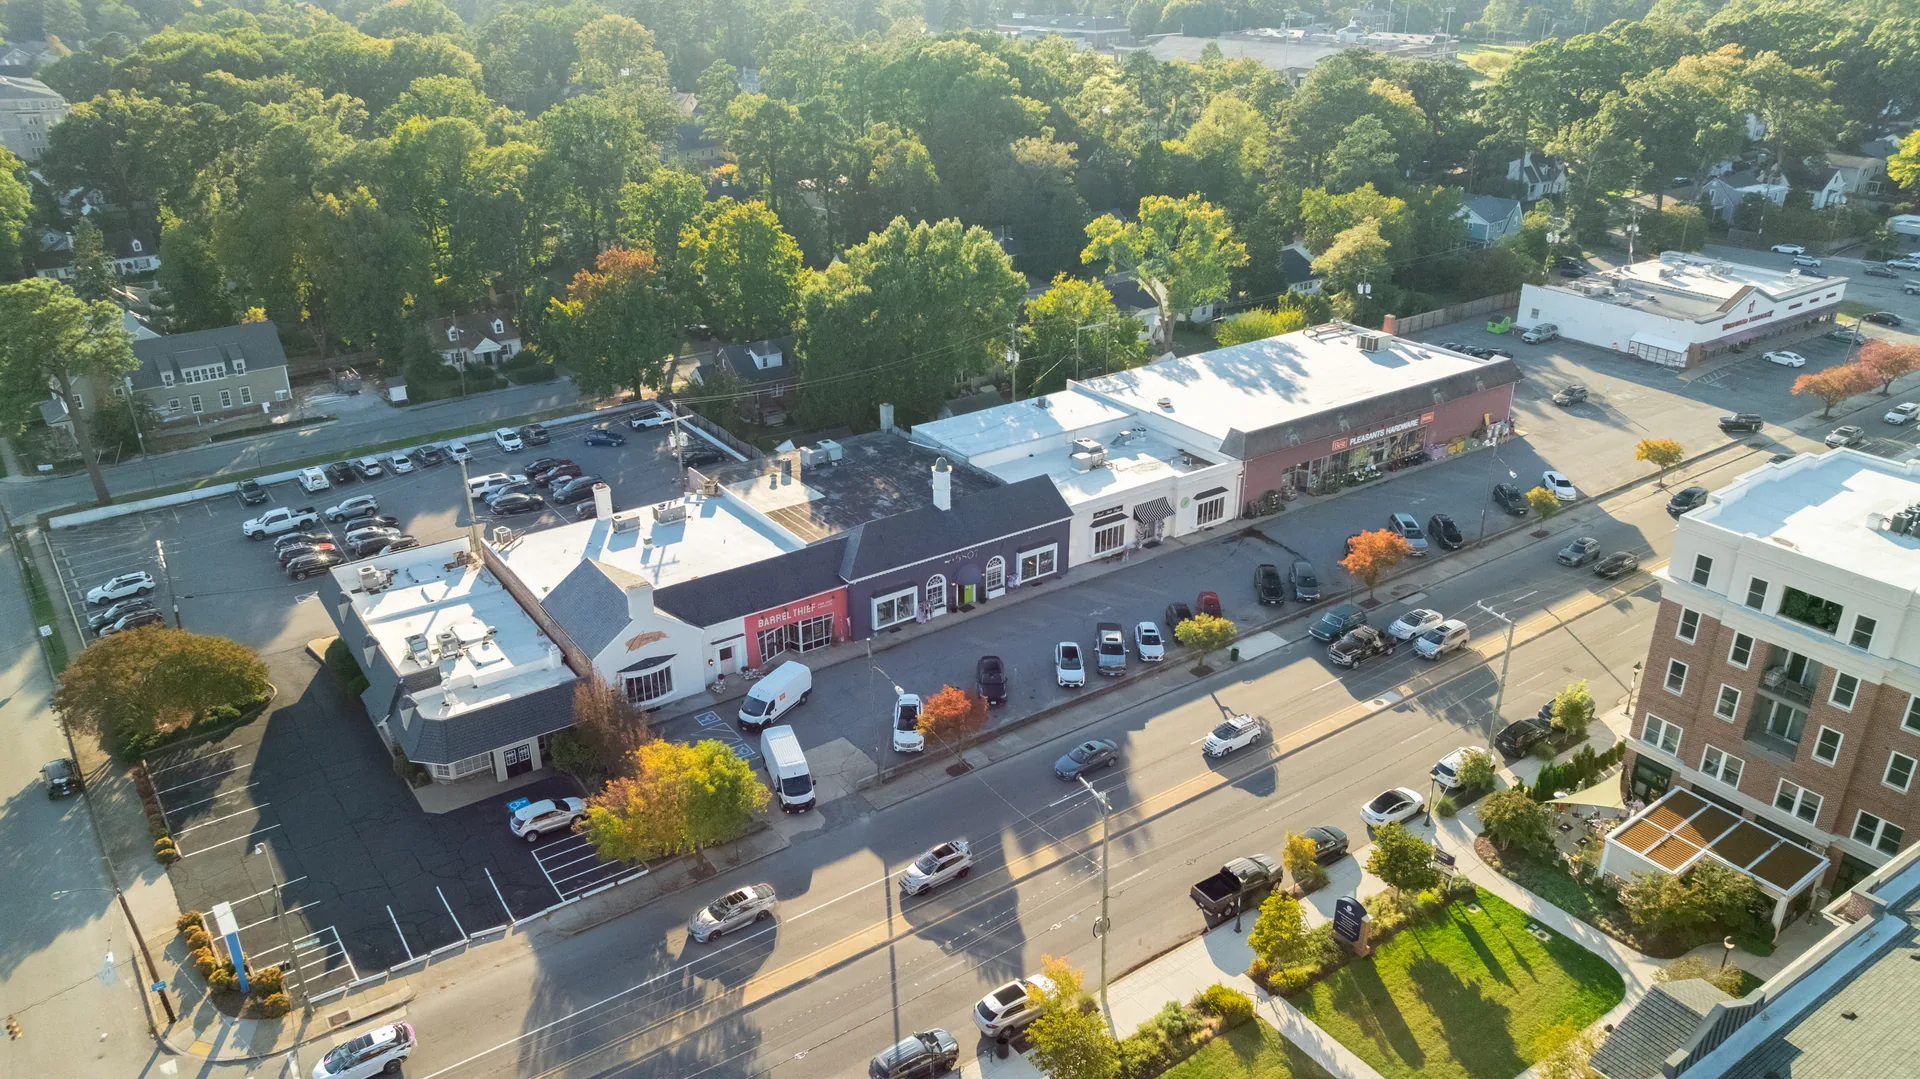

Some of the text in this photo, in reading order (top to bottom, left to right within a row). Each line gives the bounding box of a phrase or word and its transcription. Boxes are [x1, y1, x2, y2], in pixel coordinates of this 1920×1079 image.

[1349, 429, 1384, 445] PLEASANTS
[1386, 418, 1419, 435] HARDWARE
[758, 611, 791, 628] BARREL
[793, 603, 816, 617] THIEF
